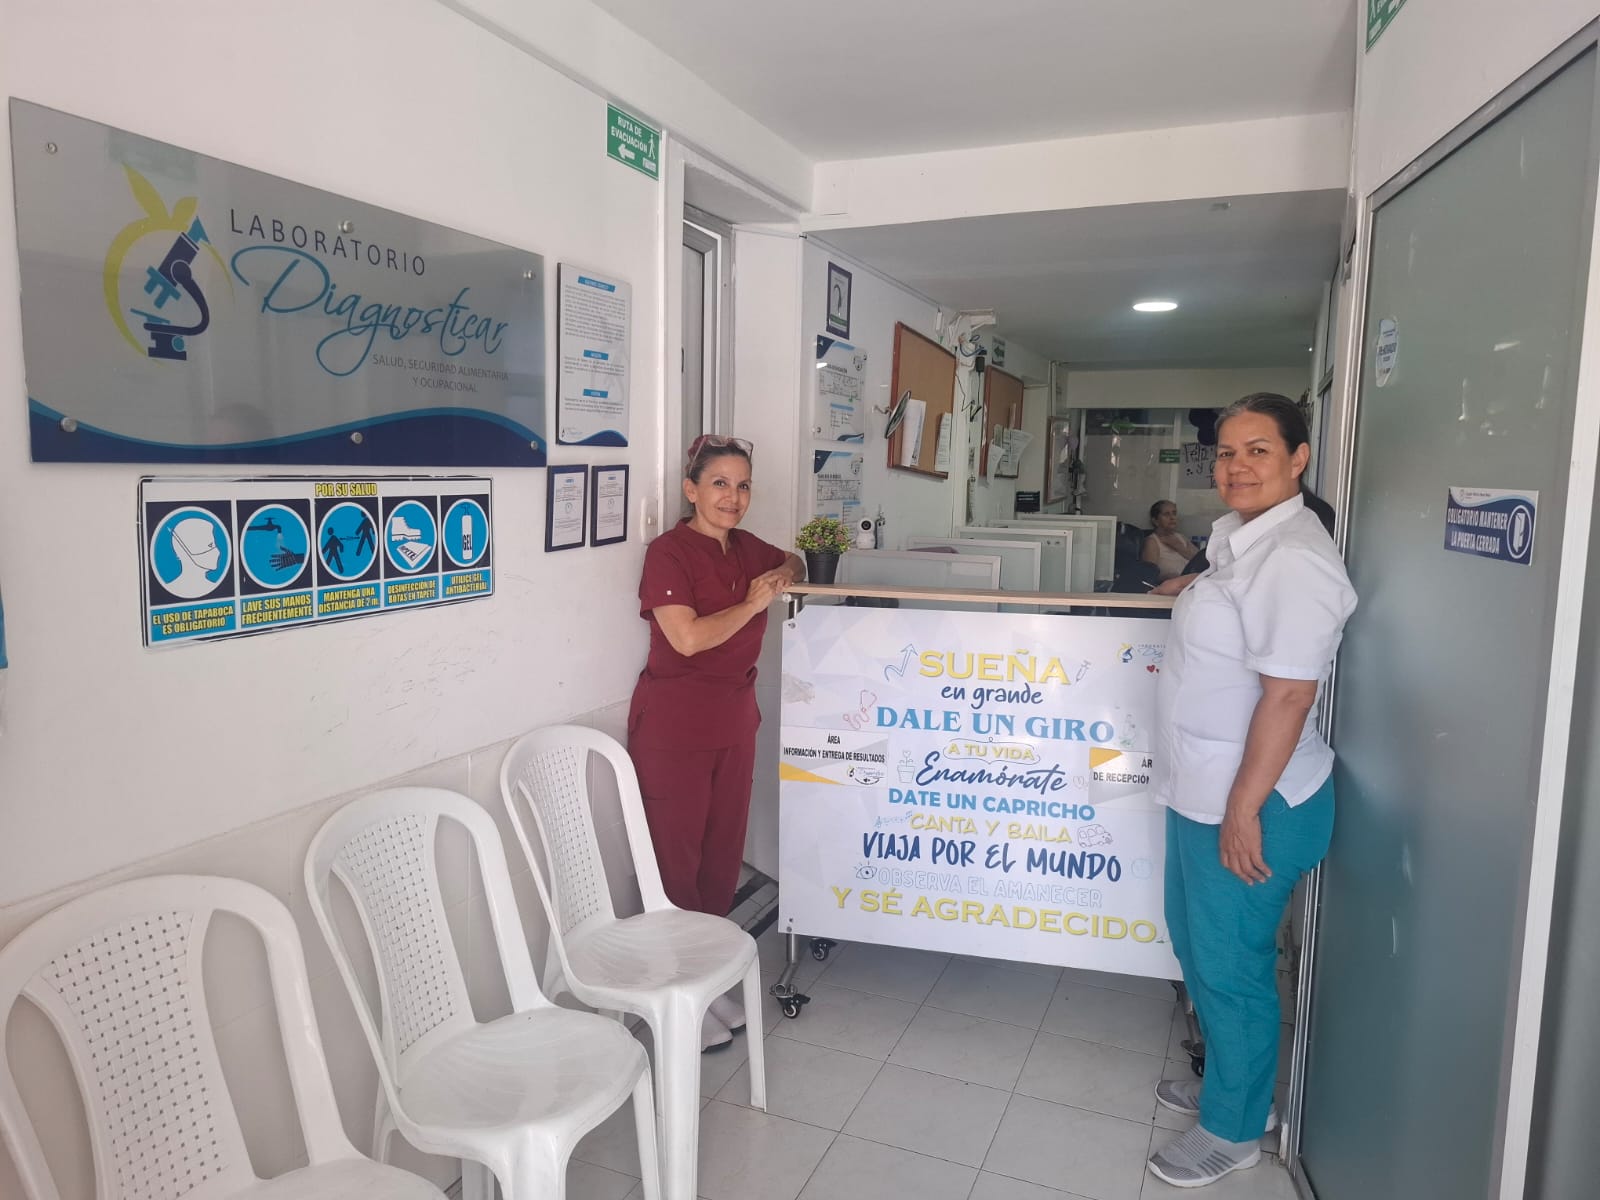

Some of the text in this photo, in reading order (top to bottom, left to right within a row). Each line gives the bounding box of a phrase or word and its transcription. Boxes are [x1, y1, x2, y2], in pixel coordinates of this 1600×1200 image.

[617, 116, 642, 138] RUTA DE
[231, 208, 426, 276] LABORATORIO
[231, 245, 508, 376] Diagnosticar
[372, 354, 509, 382] SALUD, SEGURIDAD ALIMENTARIA
[412, 376, 479, 393] Y OCUPACIONAL
[314, 482, 378, 497] POR SU SALUD
[1447, 508, 1509, 531] OBLIGATORIO MANTENER
[463, 534, 472, 551] GEL
[1451, 530, 1501, 555] LA PUERTA CERRADA
[446, 581, 488, 595] ANTIBACTERIAL
[451, 573, 482, 585] UTILICE GEL
[242, 594, 312, 613] LAVE SUS MANOS
[323, 587, 376, 603] MANTENGA UNA
[389, 590, 435, 604] BOTAS EN TAPETE
[152, 605, 234, 626] EL USO DE TAPABOCA
[241, 605, 313, 626] FRECUENTEMENTE
[319, 598, 356, 614] DISTANCIA
[356, 598, 366, 608] DE
[162, 618, 226, 635] ES OBLIGATORIO
[918, 649, 1071, 685] SUEÑA
[941, 682, 1044, 709] en grande
[876, 706, 1115, 743] DALE UN GIRO
[827, 732, 841, 745] ÁREA
[783, 746, 885, 763] INFORMACIÓN Y ENTREGA DE RESULTADOS
[947, 743, 1035, 760] A TU VIDA
[1141, 755, 1153, 769] ÁR
[915, 750, 1068, 796] Enamórate
[1093, 771, 1104, 781] DE
[888, 788, 1096, 821] DATE UN CAPRICHO
[909, 813, 1073, 844] CANTA Y BAILA
[863, 832, 921, 860] VIAJA
[931, 840, 976, 868] POR
[1026, 847, 1122, 882] MUNDO
[877, 866, 1103, 909] OBSERVA EL AMANECER
[830, 886, 1158, 944] Y SÉ AGRADECIDO
